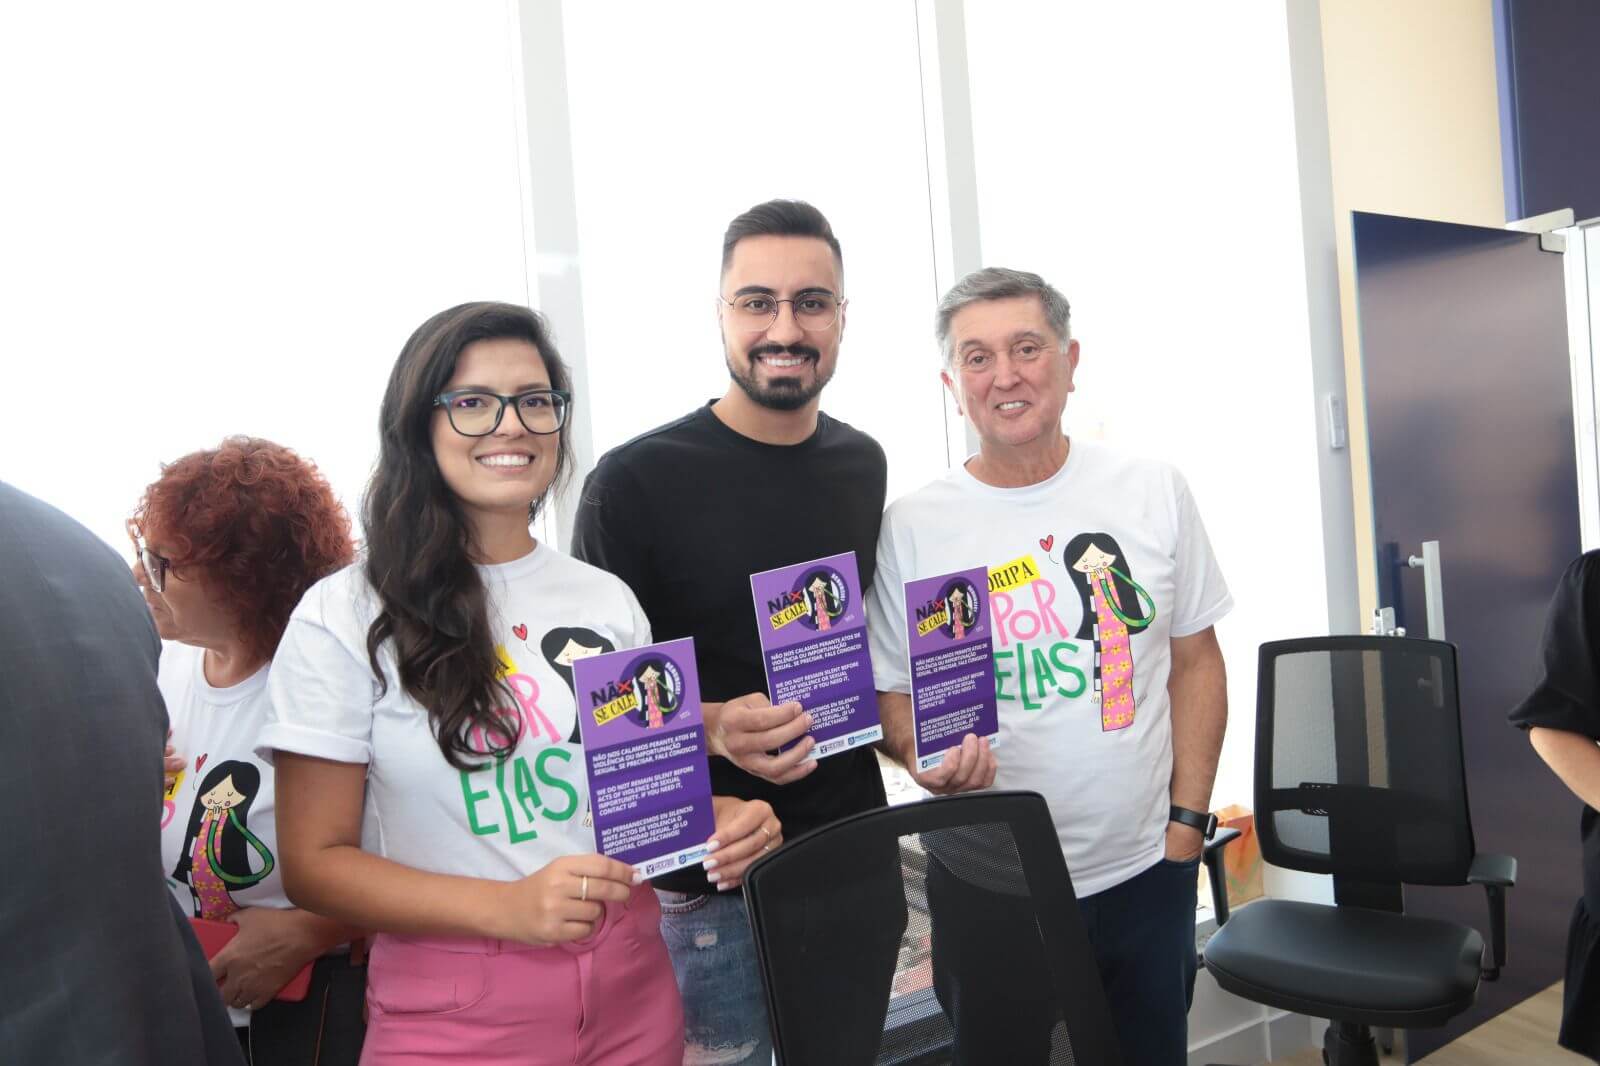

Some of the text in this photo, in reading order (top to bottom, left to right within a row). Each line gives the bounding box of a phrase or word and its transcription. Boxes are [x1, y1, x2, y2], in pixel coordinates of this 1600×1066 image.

[988, 561, 1034, 592] ORIPA
[771, 600, 809, 628] SE CALE!
[918, 619, 930, 634] SE
[990, 579, 1070, 646] POR
[994, 642, 1087, 710] ELAS
[594, 693, 638, 725] SE CALE!
[460, 748, 579, 845] ELAS
